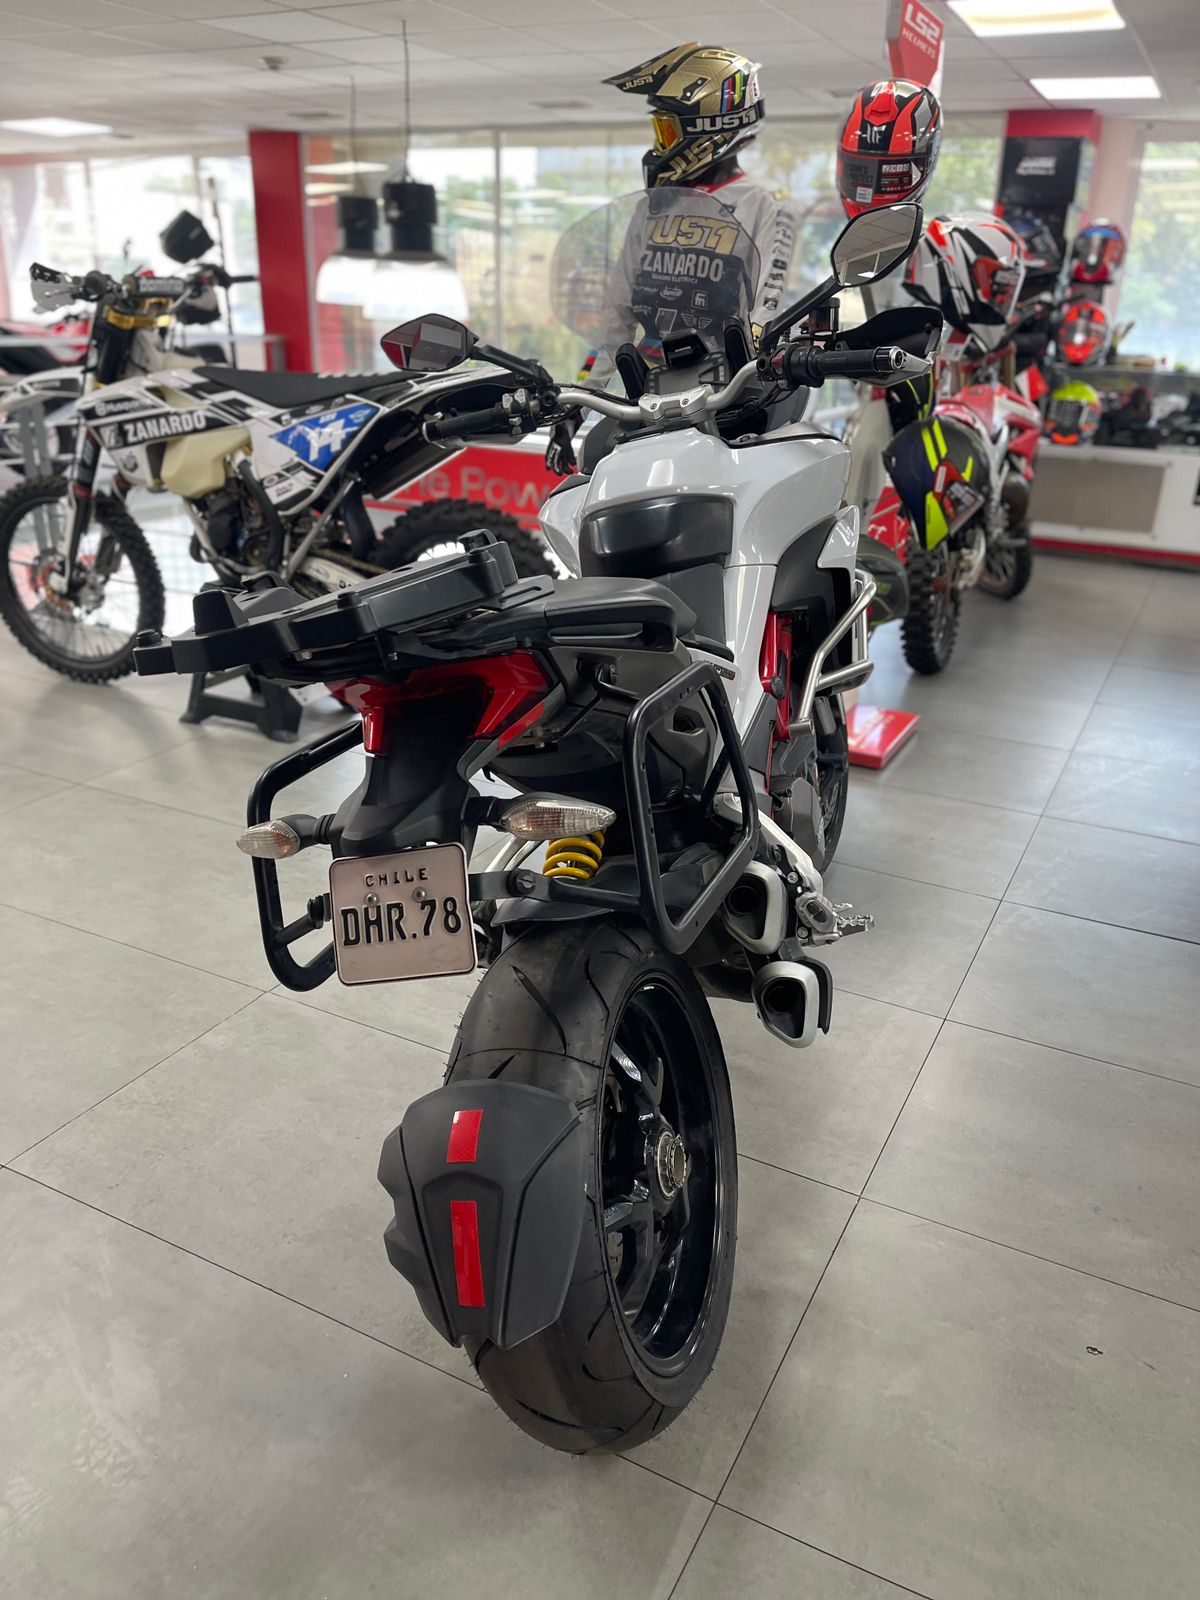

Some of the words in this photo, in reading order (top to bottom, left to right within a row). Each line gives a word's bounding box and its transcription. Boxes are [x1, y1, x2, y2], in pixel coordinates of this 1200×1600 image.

[904, 3, 940, 46] LS2
[648, 215, 740, 255] UST1
[643, 251, 724, 282] ZANARDO
[124, 410, 207, 443] ZANARDO
[365, 868, 428, 887] CHILE
